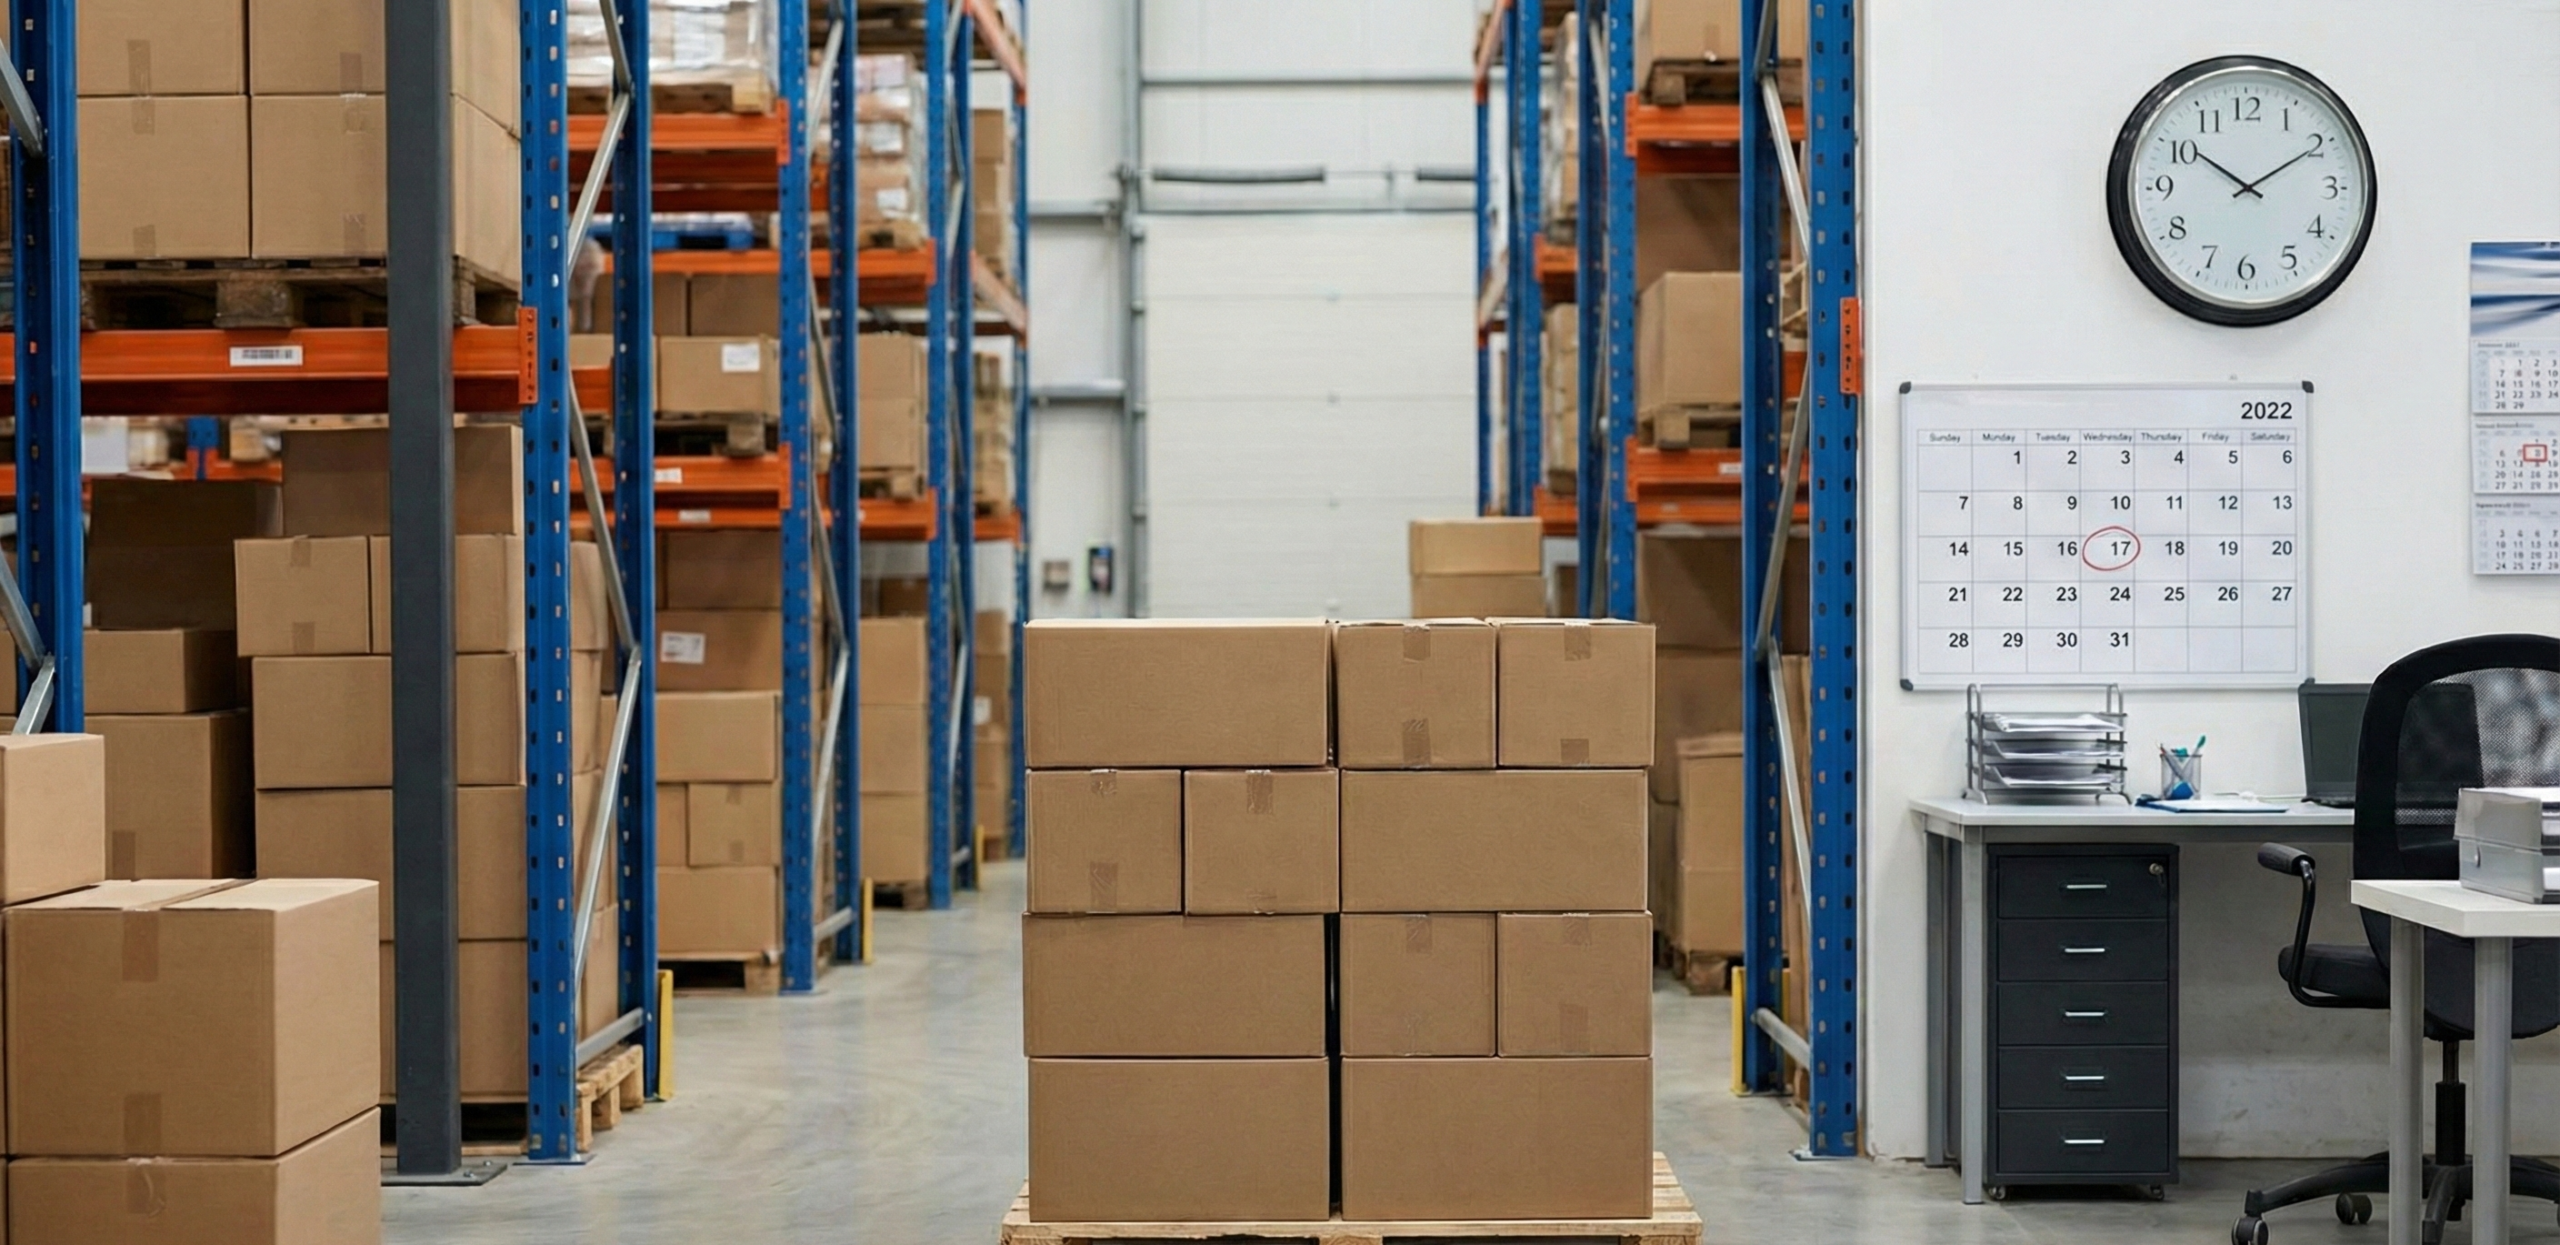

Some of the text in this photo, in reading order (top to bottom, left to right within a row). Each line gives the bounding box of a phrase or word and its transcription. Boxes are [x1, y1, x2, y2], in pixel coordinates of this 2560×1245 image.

[2232, 95, 2261, 121] 12
[2281, 107, 2289, 131] 1
[2197, 108, 2220, 134] 11
[2170, 139, 2197, 165] 10
[2307, 133, 2324, 158] 2
[2156, 175, 2174, 201] 9
[2322, 175, 2338, 200] 3
[2169, 215, 2187, 240] 8
[2307, 214, 2325, 238] 4
[2202, 245, 2218, 269] 7
[2237, 254, 2256, 281] 6
[2281, 245, 2298, 269] 5
[2241, 402, 2292, 419] 2022
[2014, 450, 2292, 464] 1 2 3 4 5 6
[1959, 495, 2292, 510] 7 8 9 10 11 12 13
[1950, 541, 2292, 556] 14 15 16 17 18 19 20
[1949, 587, 2292, 601] 21 22 23 24 25 26 27
[1949, 632, 2128, 647] 28 29 30 31
